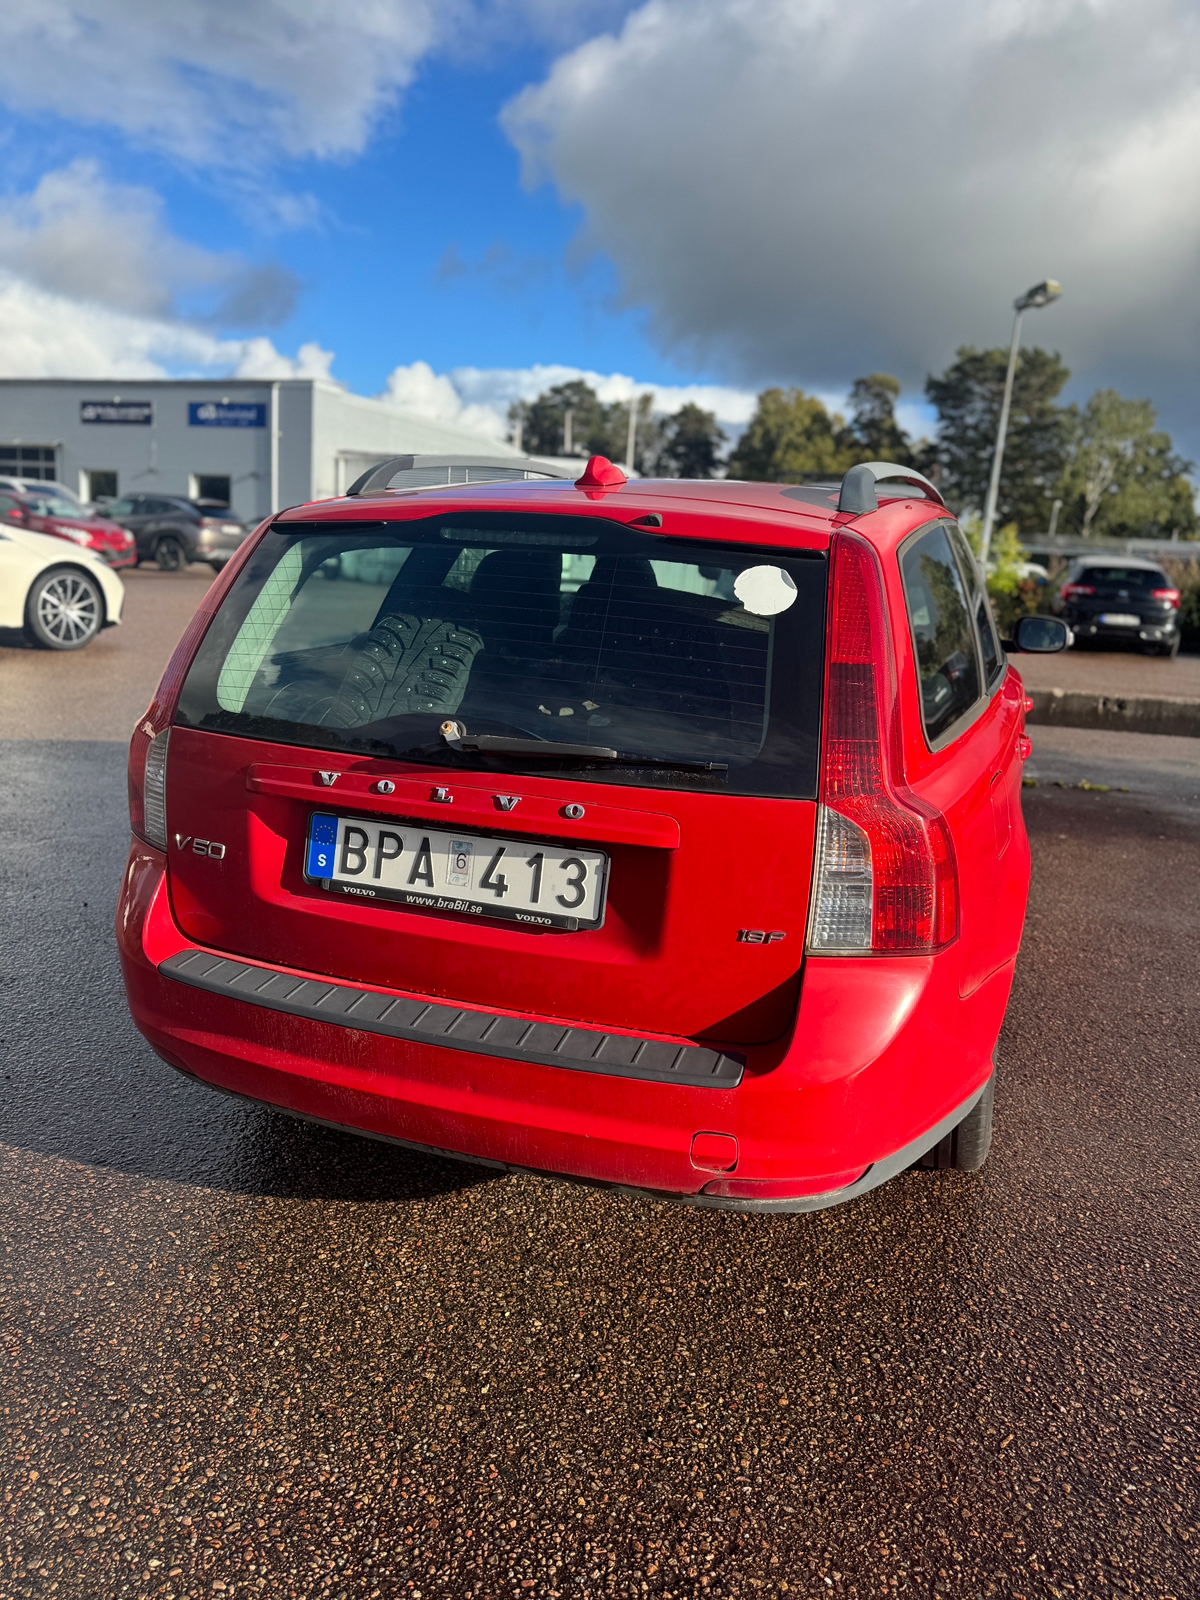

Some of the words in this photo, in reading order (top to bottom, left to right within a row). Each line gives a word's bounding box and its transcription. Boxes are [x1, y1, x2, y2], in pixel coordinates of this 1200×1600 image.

[319, 771, 585, 819] VOLVO
[175, 833, 226, 860] V50
[317, 853, 327, 867] S
[339, 825, 435, 888] BPA
[479, 847, 588, 909] 413
[456, 852, 467, 869] 6
[342, 886, 376, 897] VOLVO
[406, 894, 483, 914] www.braBil.se
[515, 913, 552, 925] VOLVO
